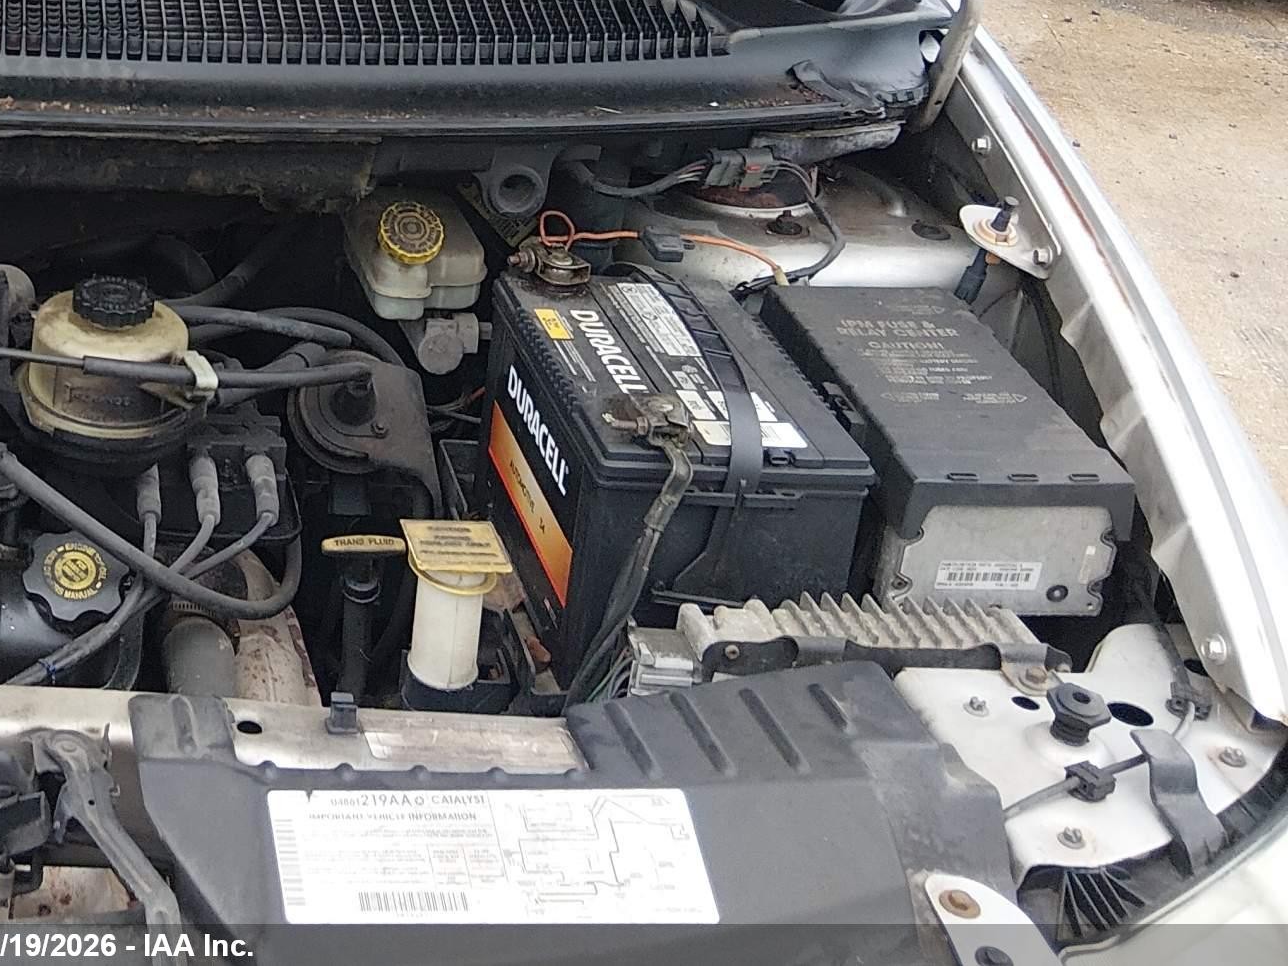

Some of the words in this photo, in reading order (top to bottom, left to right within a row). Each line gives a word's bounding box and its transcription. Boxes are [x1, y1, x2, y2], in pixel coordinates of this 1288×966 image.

[876, 320, 918, 329] FUSE
[921, 320, 937, 329] &
[836, 327, 889, 338] RELAY
[893, 328, 960, 338] CENTER
[569, 309, 649, 395] DURACELL
[508, 365, 566, 497] DURACELL
[334, 537, 365, 547] TRANS
[367, 538, 395, 547] FLUID
[431, 795, 485, 806] CATALYST
[408, 812, 477, 821] INFORMATION
